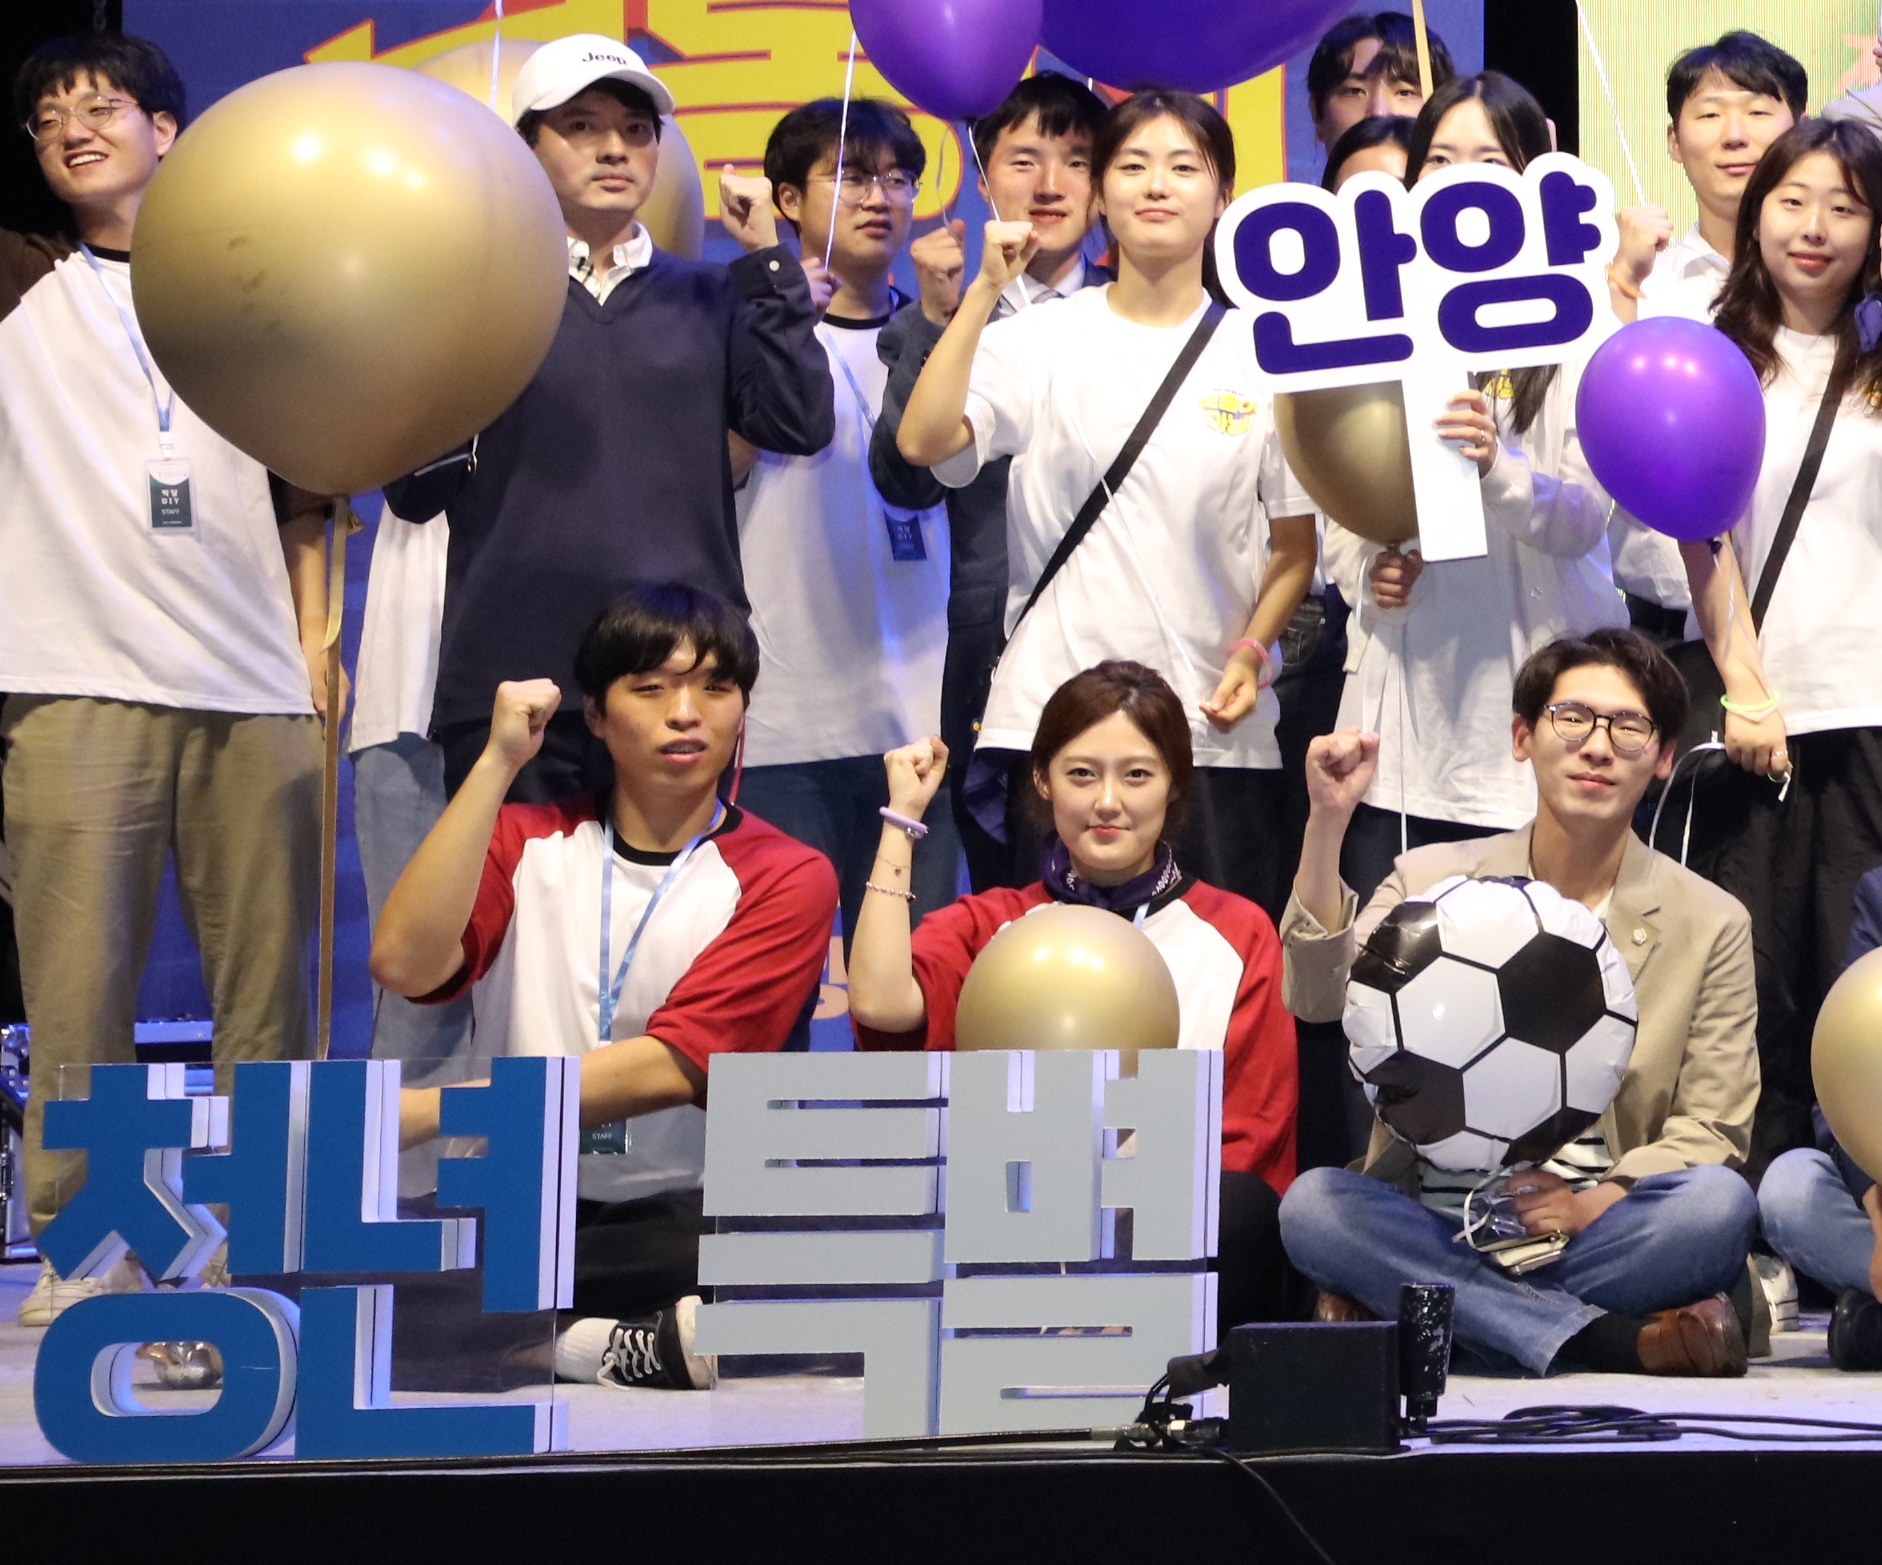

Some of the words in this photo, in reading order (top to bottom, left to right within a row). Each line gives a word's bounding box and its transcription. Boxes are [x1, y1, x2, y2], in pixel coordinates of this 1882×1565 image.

[1233, 170, 1602, 375] 안양
[34, 1055, 580, 1465] 청년
[694, 1049, 1224, 1450] 특별
